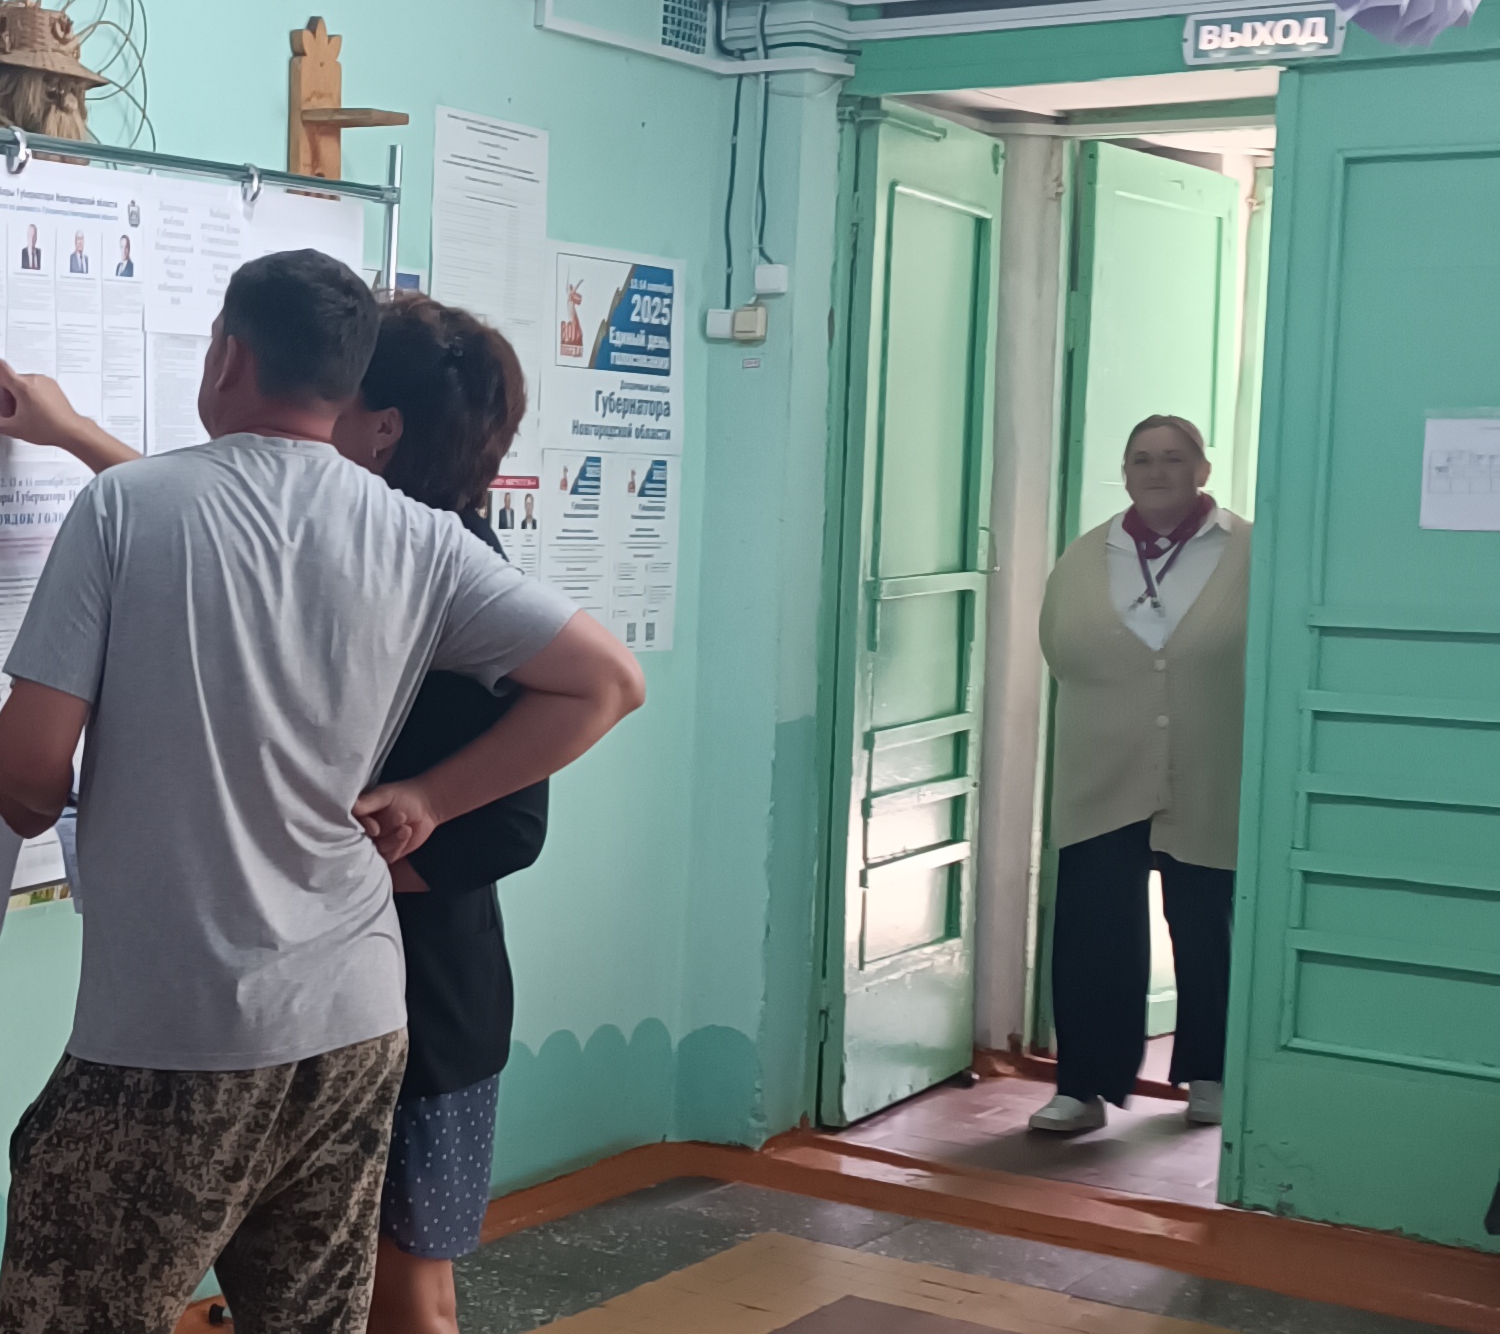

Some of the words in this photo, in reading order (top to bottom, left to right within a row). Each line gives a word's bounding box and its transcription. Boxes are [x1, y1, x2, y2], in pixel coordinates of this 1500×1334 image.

[1198, 17, 1329, 51] ВЫХОД
[630, 294, 672, 326] 2025
[595, 390, 671, 422] Губернатора
